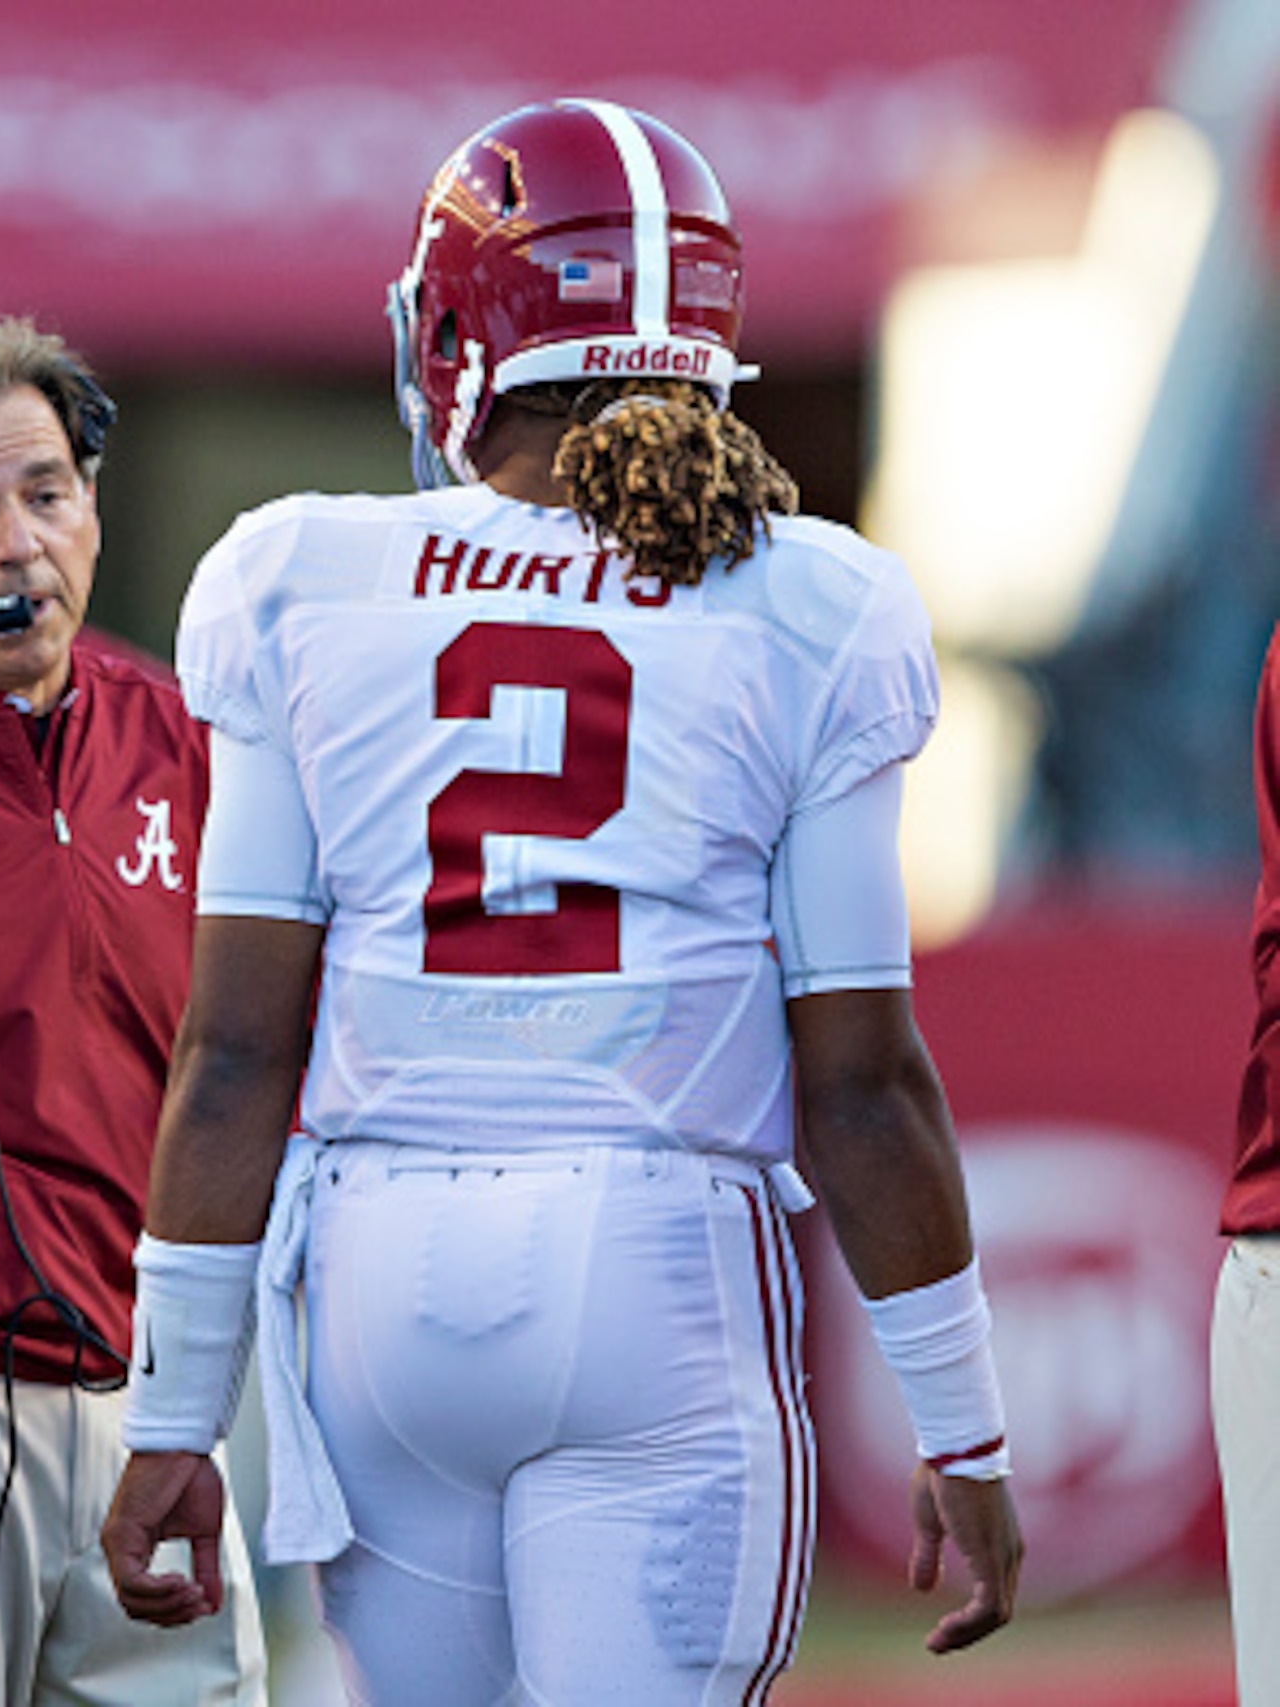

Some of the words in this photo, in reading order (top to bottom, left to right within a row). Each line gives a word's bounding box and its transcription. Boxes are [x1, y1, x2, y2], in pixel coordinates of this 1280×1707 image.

[582, 344, 712, 376] Riddell
[115, 796, 184, 890] A
[421, 622, 633, 974] 2
